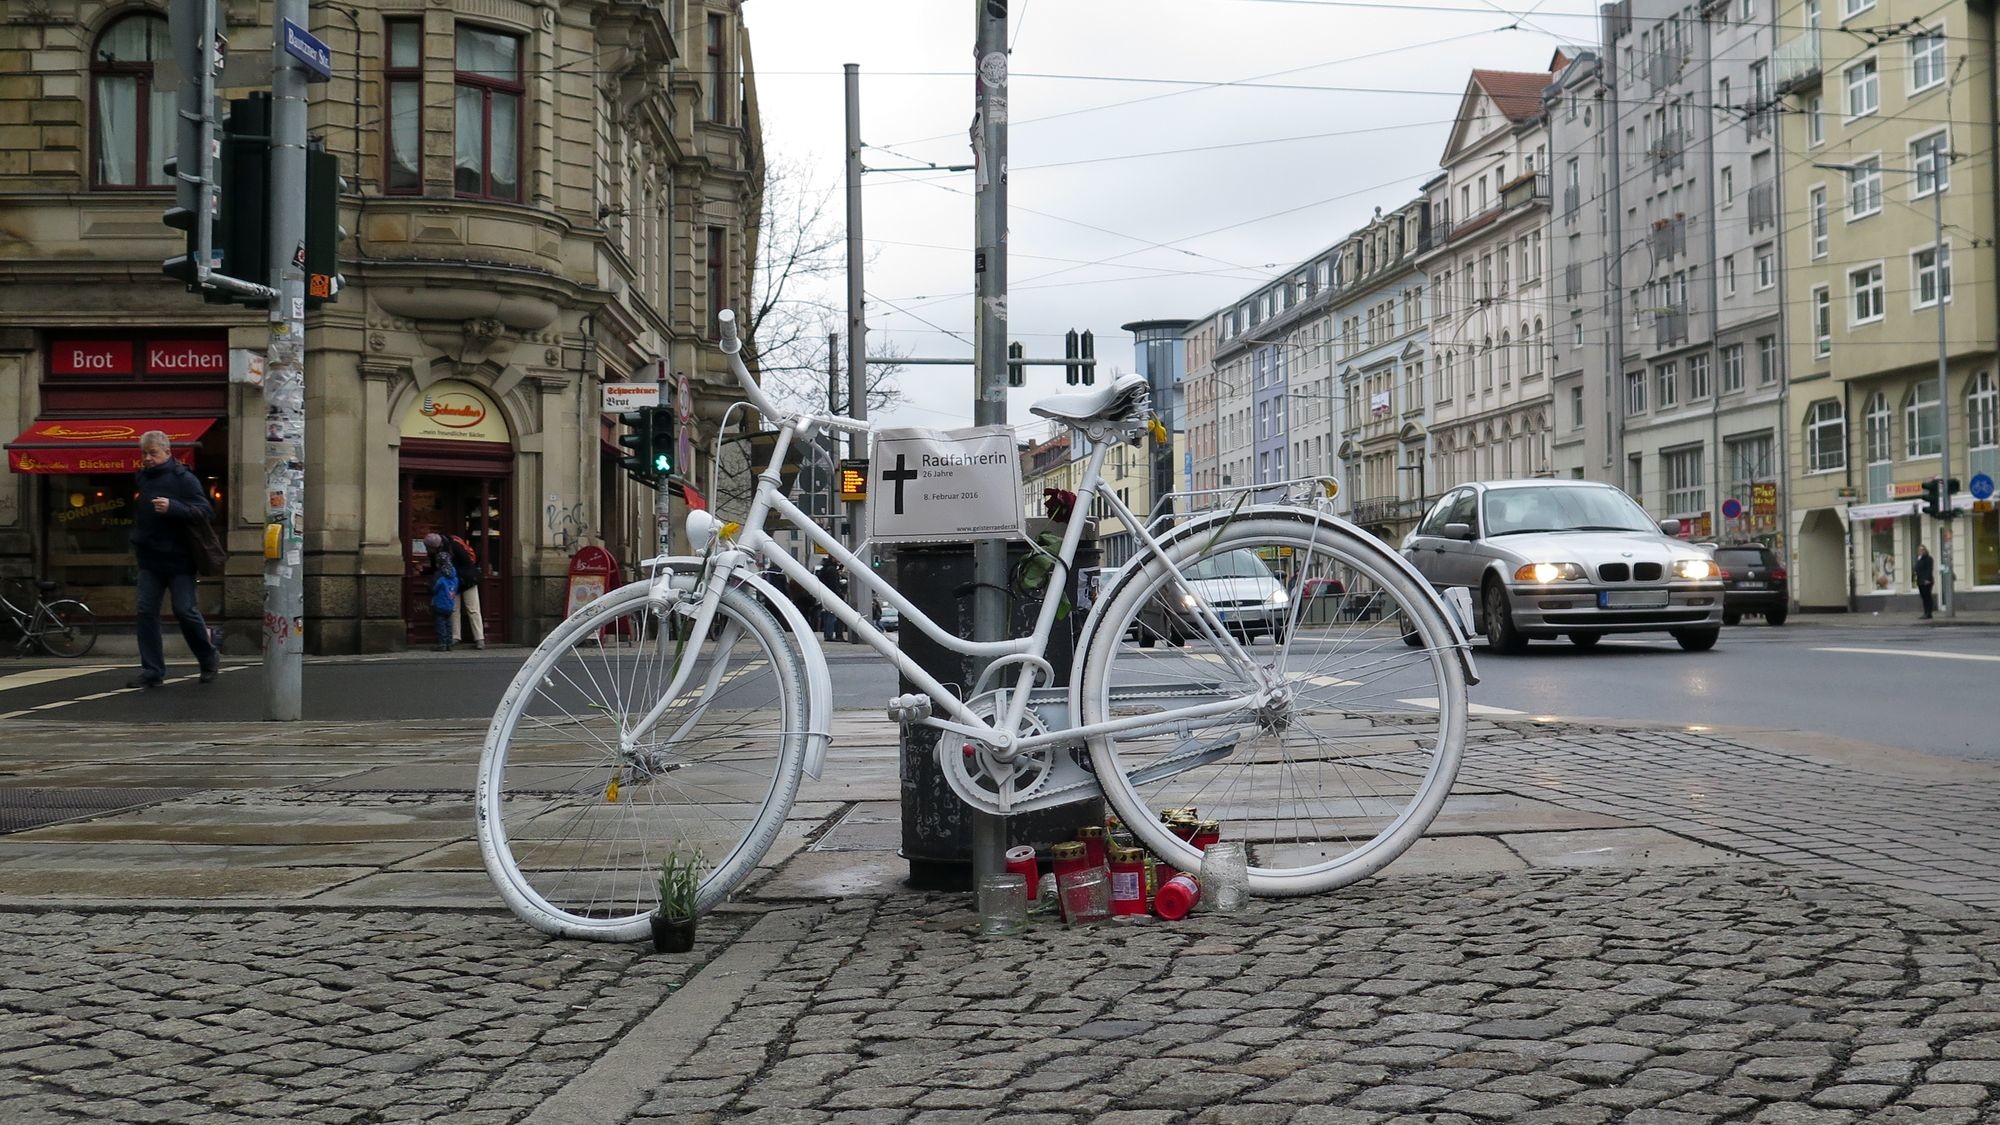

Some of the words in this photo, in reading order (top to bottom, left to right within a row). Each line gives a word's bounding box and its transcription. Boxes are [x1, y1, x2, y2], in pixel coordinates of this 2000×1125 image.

[73, 350, 114, 368] Brot
[151, 350, 224, 368] Kuchen
[606, 397, 629, 406] Brot
[79, 459, 125, 469] Bäckerei
[922, 452, 1007, 467] Radfahrerin
[934, 470, 953, 478] Jahre
[923, 493, 931, 501] 8.
[932, 492, 959, 500] Februar
[961, 491, 979, 499] 2016
